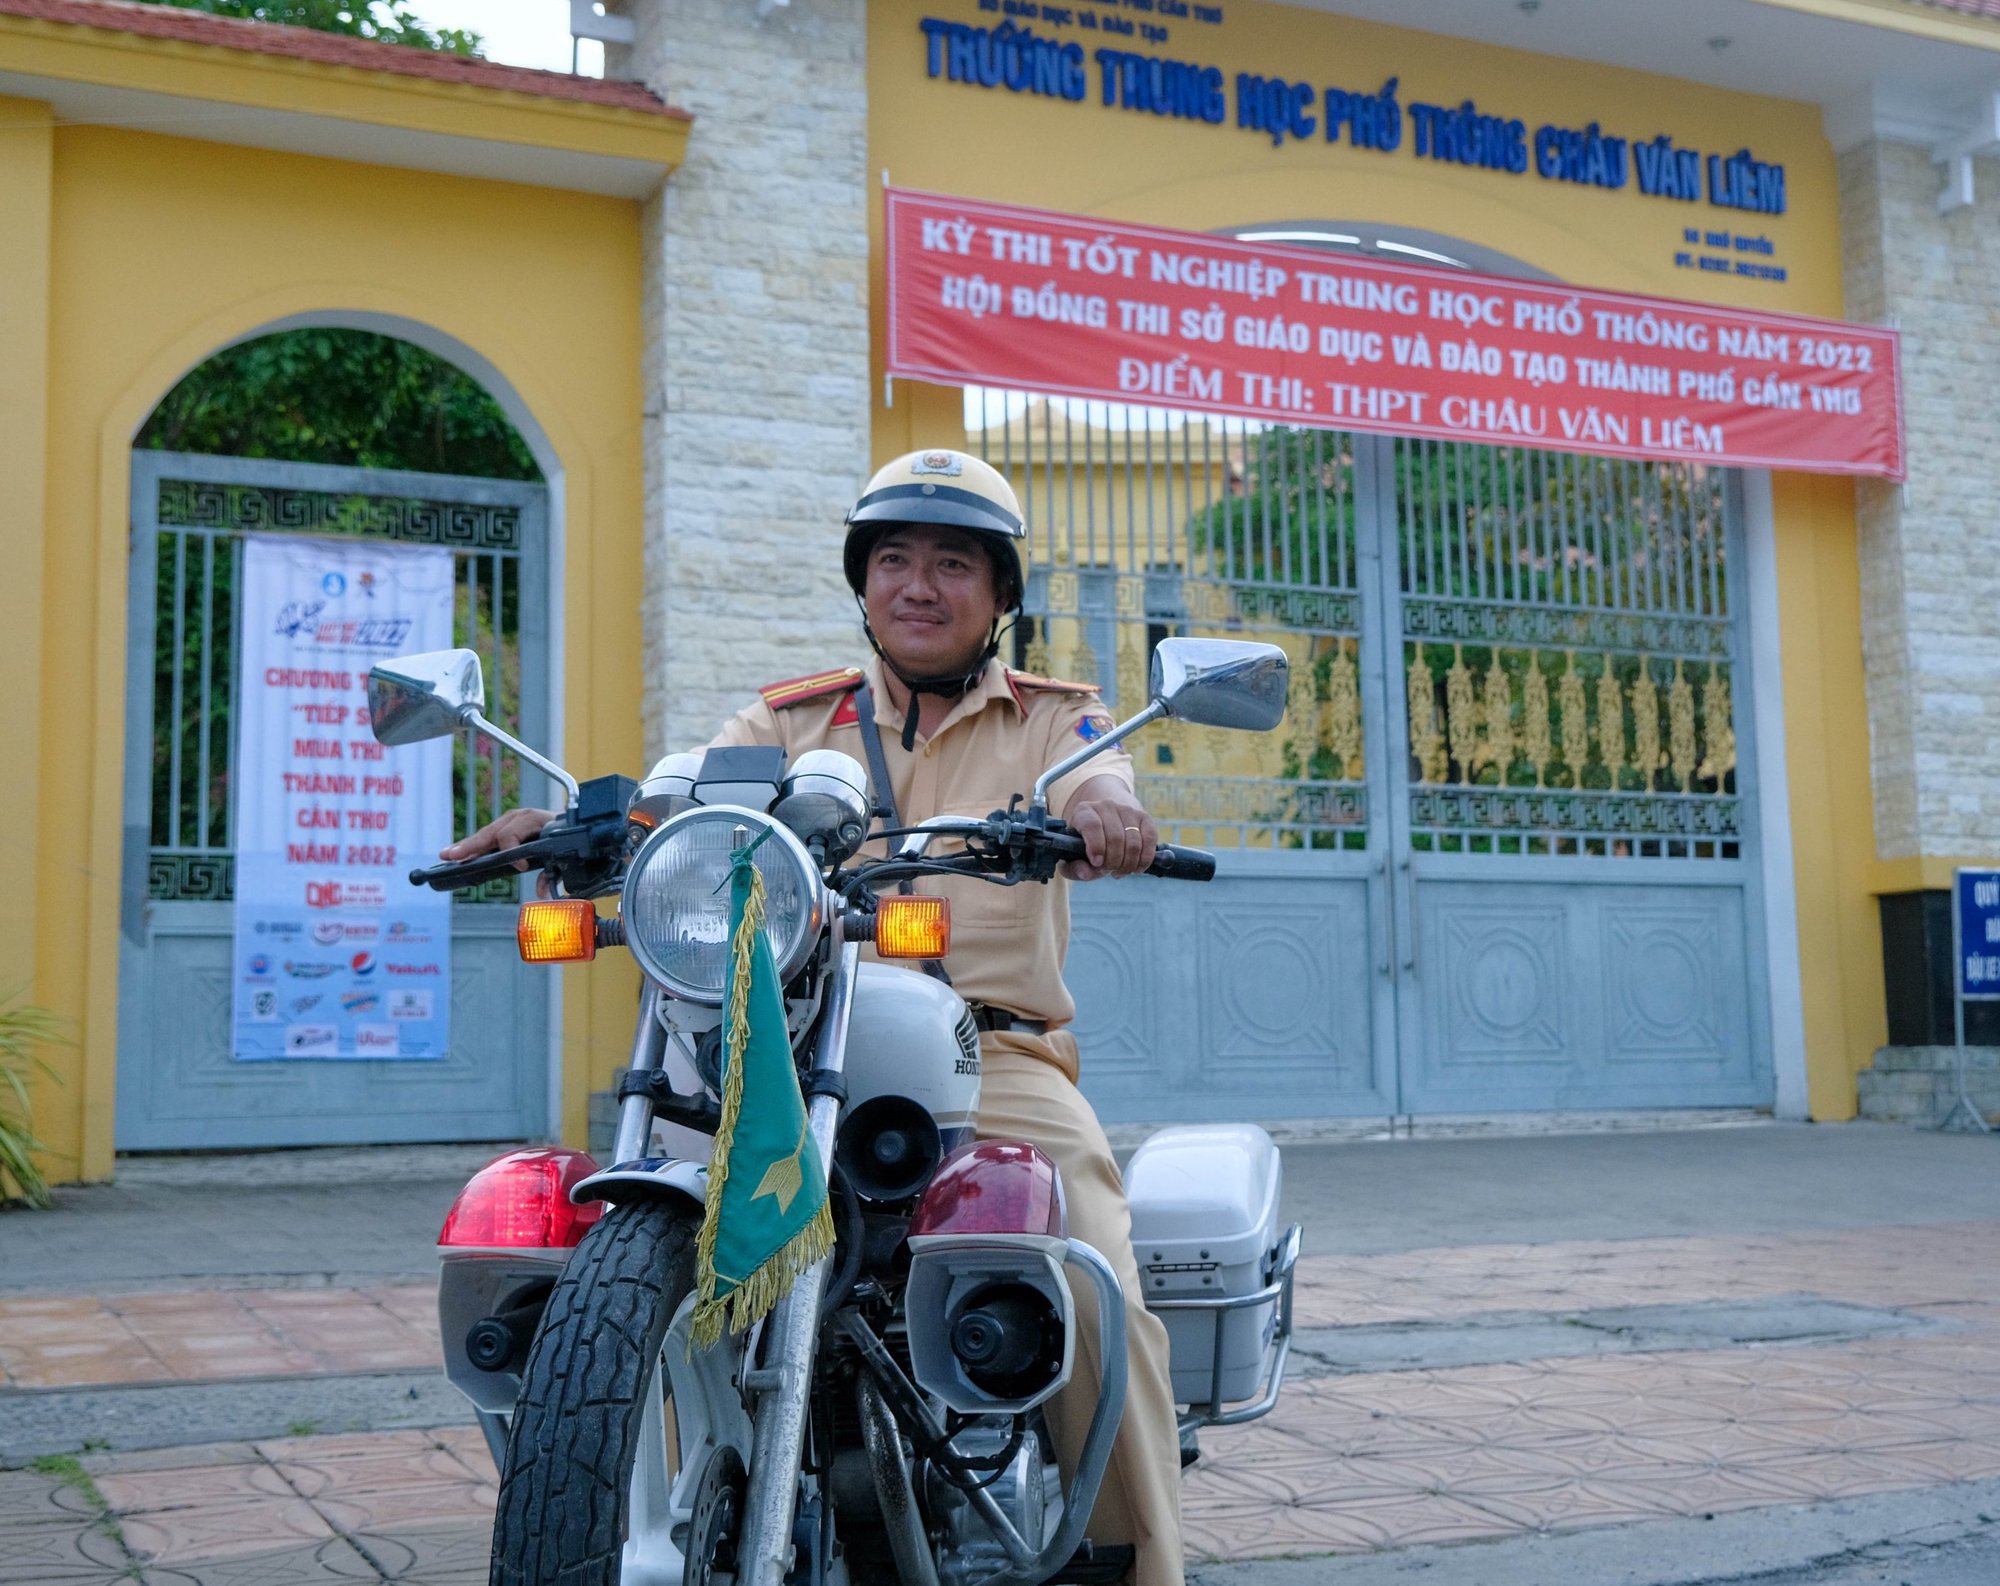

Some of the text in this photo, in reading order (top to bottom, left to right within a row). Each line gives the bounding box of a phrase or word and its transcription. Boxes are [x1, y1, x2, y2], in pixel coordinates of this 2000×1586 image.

[920, 15, 1787, 214] TRƯỜNG TRUNG HỌC PHỐ THÔNG CHÂU VĂN LIÊM
[986, 225, 1051, 267] THI
[1062, 235, 1140, 281] TỐT
[1150, 250, 1287, 303] NGHIỆP
[1296, 271, 1418, 316] TRUNG
[1429, 287, 1504, 331] HỌC
[1514, 296, 1584, 337] PHỐ
[1593, 309, 1709, 353] THÔNG
[1718, 325, 1789, 364] NĂM
[1798, 338, 1873, 373] 2022
[941, 274, 1001, 319] HỘI
[1117, 299, 1169, 337] THI
[1179, 304, 1226, 344] SỞ
[1234, 314, 1310, 355] GIÁO
[1318, 326, 1382, 367] DỤC
[1393, 335, 1433, 368] VÀ
[1440, 340, 1502, 377] ĐÀO
[1511, 349, 1567, 388] TẠO
[1574, 355, 1671, 397] THÀNH
[1678, 366, 1736, 404] PHỐ
[1808, 383, 1863, 416] THƠ
[1117, 353, 1725, 455] ĐIỂM THI: THPT CHÂU VĂN LIÊM
[265, 668, 353, 690] CHƯƠNG
[282, 771, 405, 797] THÀNH PHỐ
[296, 803, 390, 830] CẦN THƠ
[288, 841, 397, 867] NĂM 2022
